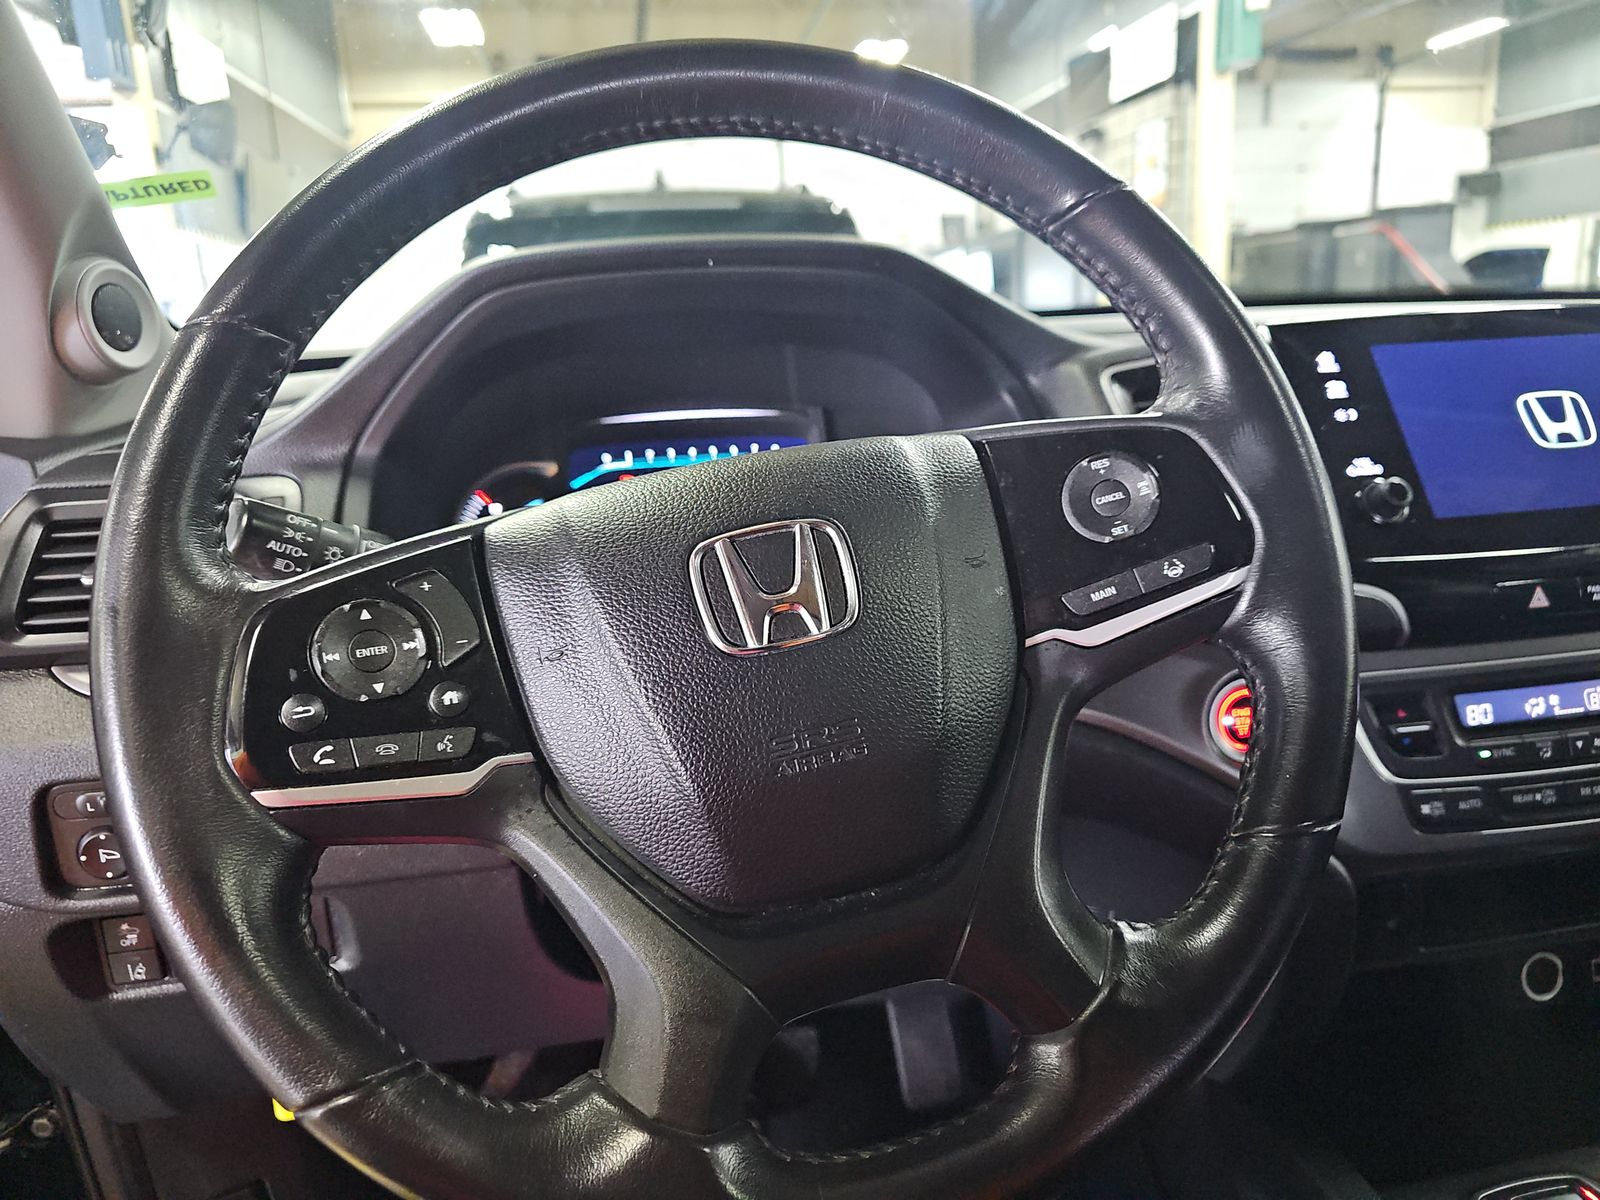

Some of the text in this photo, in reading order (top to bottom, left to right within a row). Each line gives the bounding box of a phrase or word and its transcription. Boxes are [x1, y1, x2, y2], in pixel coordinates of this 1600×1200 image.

[1090, 458, 1110, 470] RES
[1095, 491, 1126, 505] CANCEL
[286, 514, 313, 527] OFF
[1110, 524, 1130, 536] SET
[266, 540, 303, 558] AUTO
[1090, 585, 1118, 602] MAIN
[355, 645, 389, 658] ENTER
[120, 938, 138, 947] OFF
